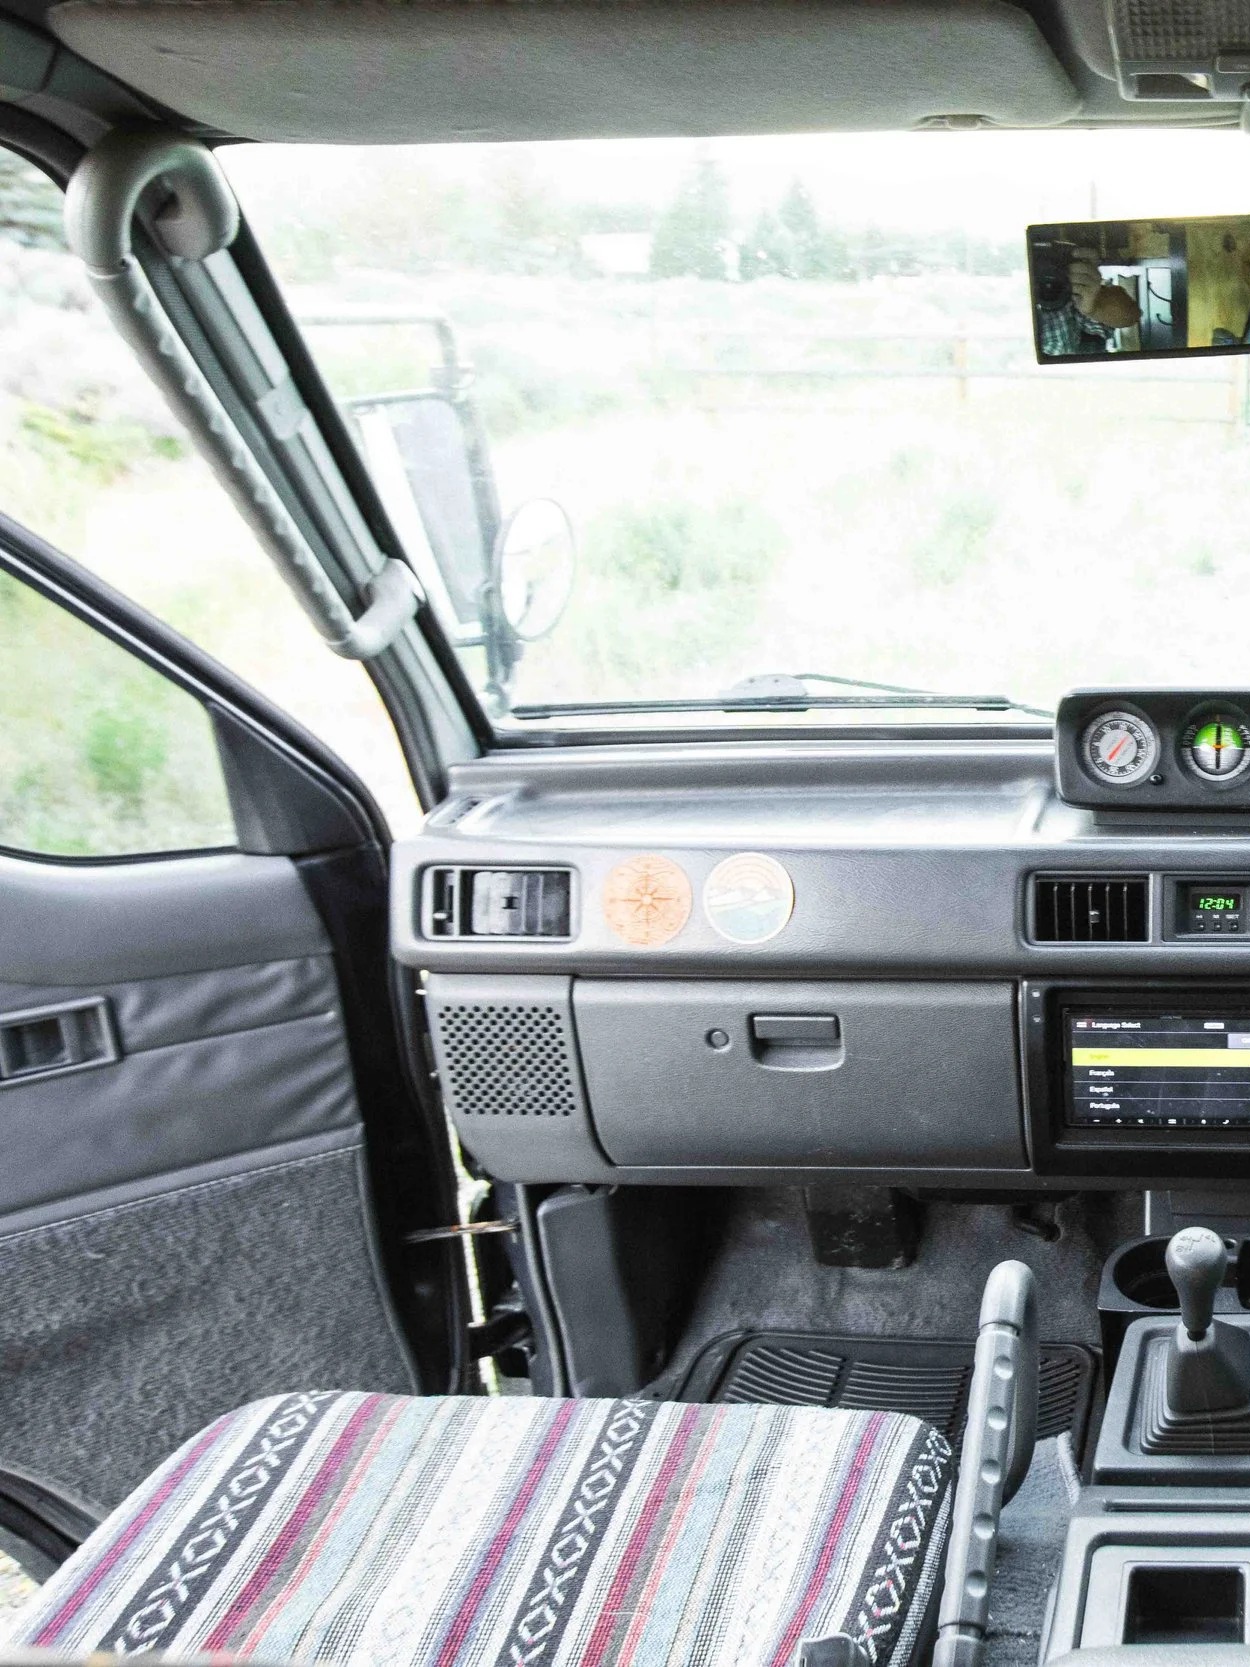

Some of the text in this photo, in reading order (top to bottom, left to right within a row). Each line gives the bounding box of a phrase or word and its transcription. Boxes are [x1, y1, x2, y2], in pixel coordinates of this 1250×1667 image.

[1199, 897, 1234, 910] 12:04
[1091, 1021, 1141, 1029] Language Select
